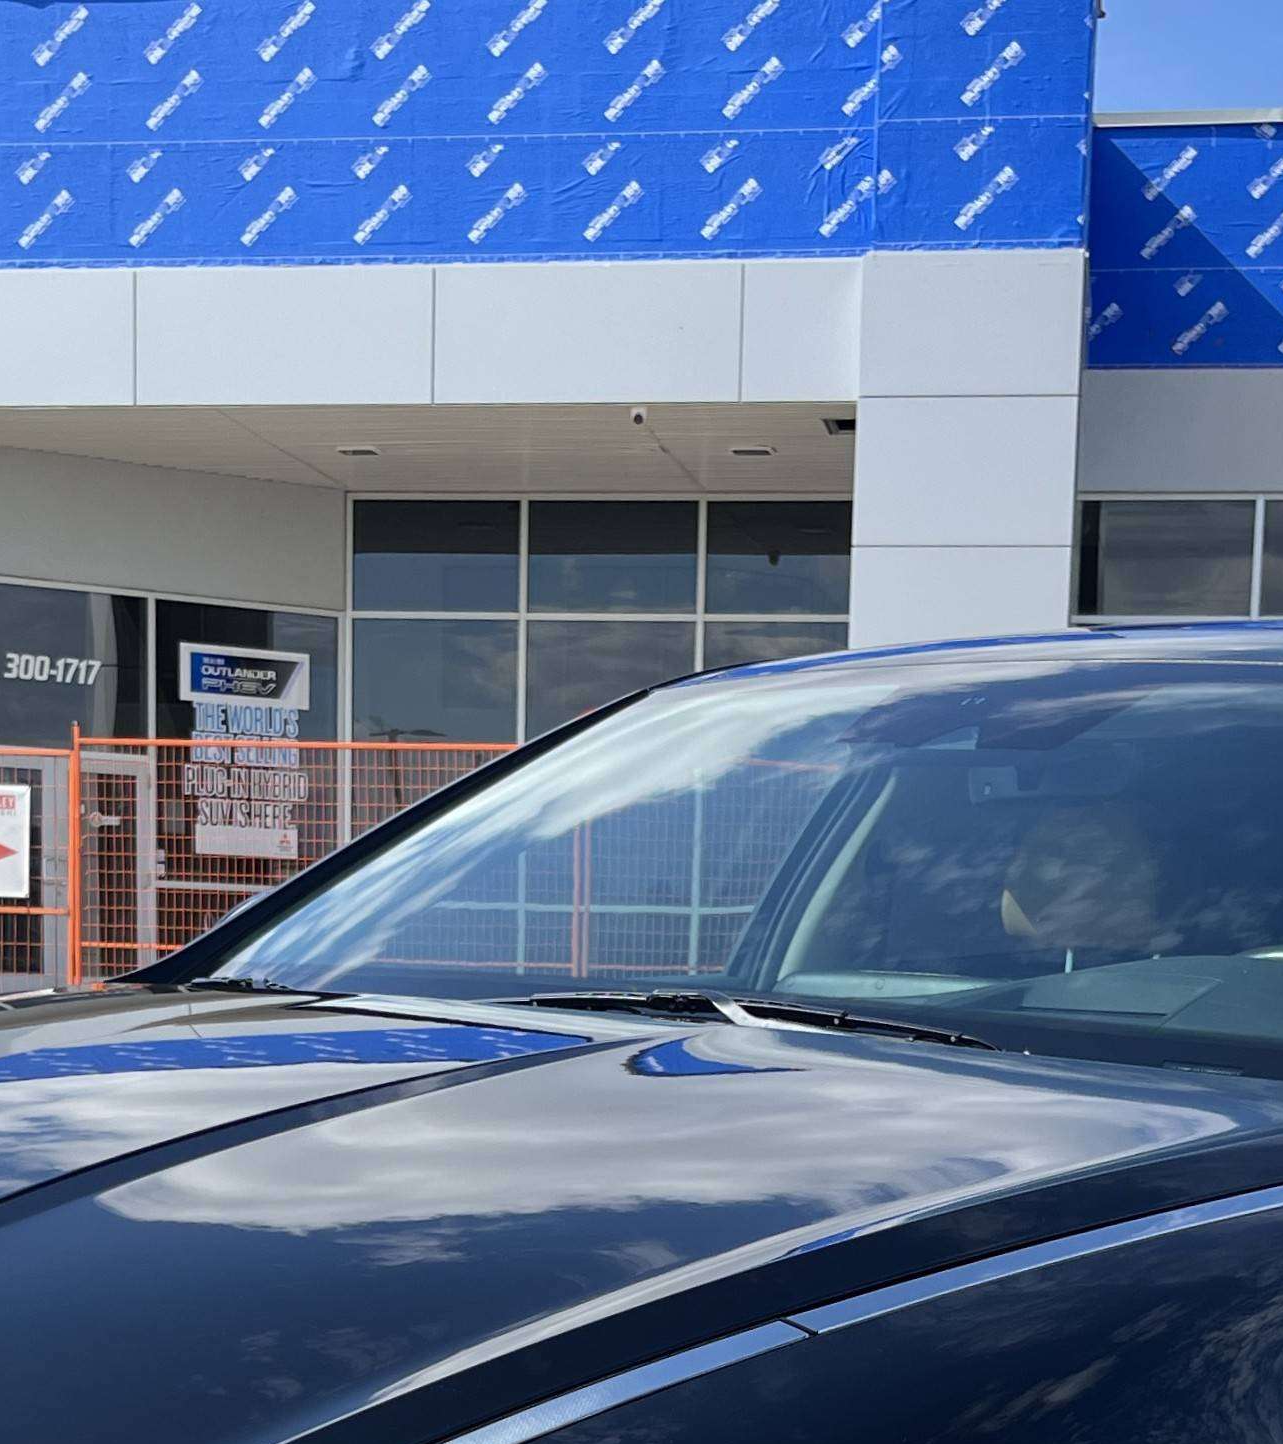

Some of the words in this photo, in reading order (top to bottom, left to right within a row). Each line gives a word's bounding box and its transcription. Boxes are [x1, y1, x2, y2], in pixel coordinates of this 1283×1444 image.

[3, 652, 102, 686] 300-1717
[201, 665, 277, 681] OUTLANDER
[202, 677, 277, 695] PHEV
[195, 702, 227, 732] THE
[228, 705, 299, 738] WORLD'S
[192, 732, 232, 764] BEST
[234, 735, 299, 767] SELLING
[185, 766, 250, 798] PLUG-IN
[251, 769, 309, 801] HYBRID
[199, 799, 232, 827] SUV
